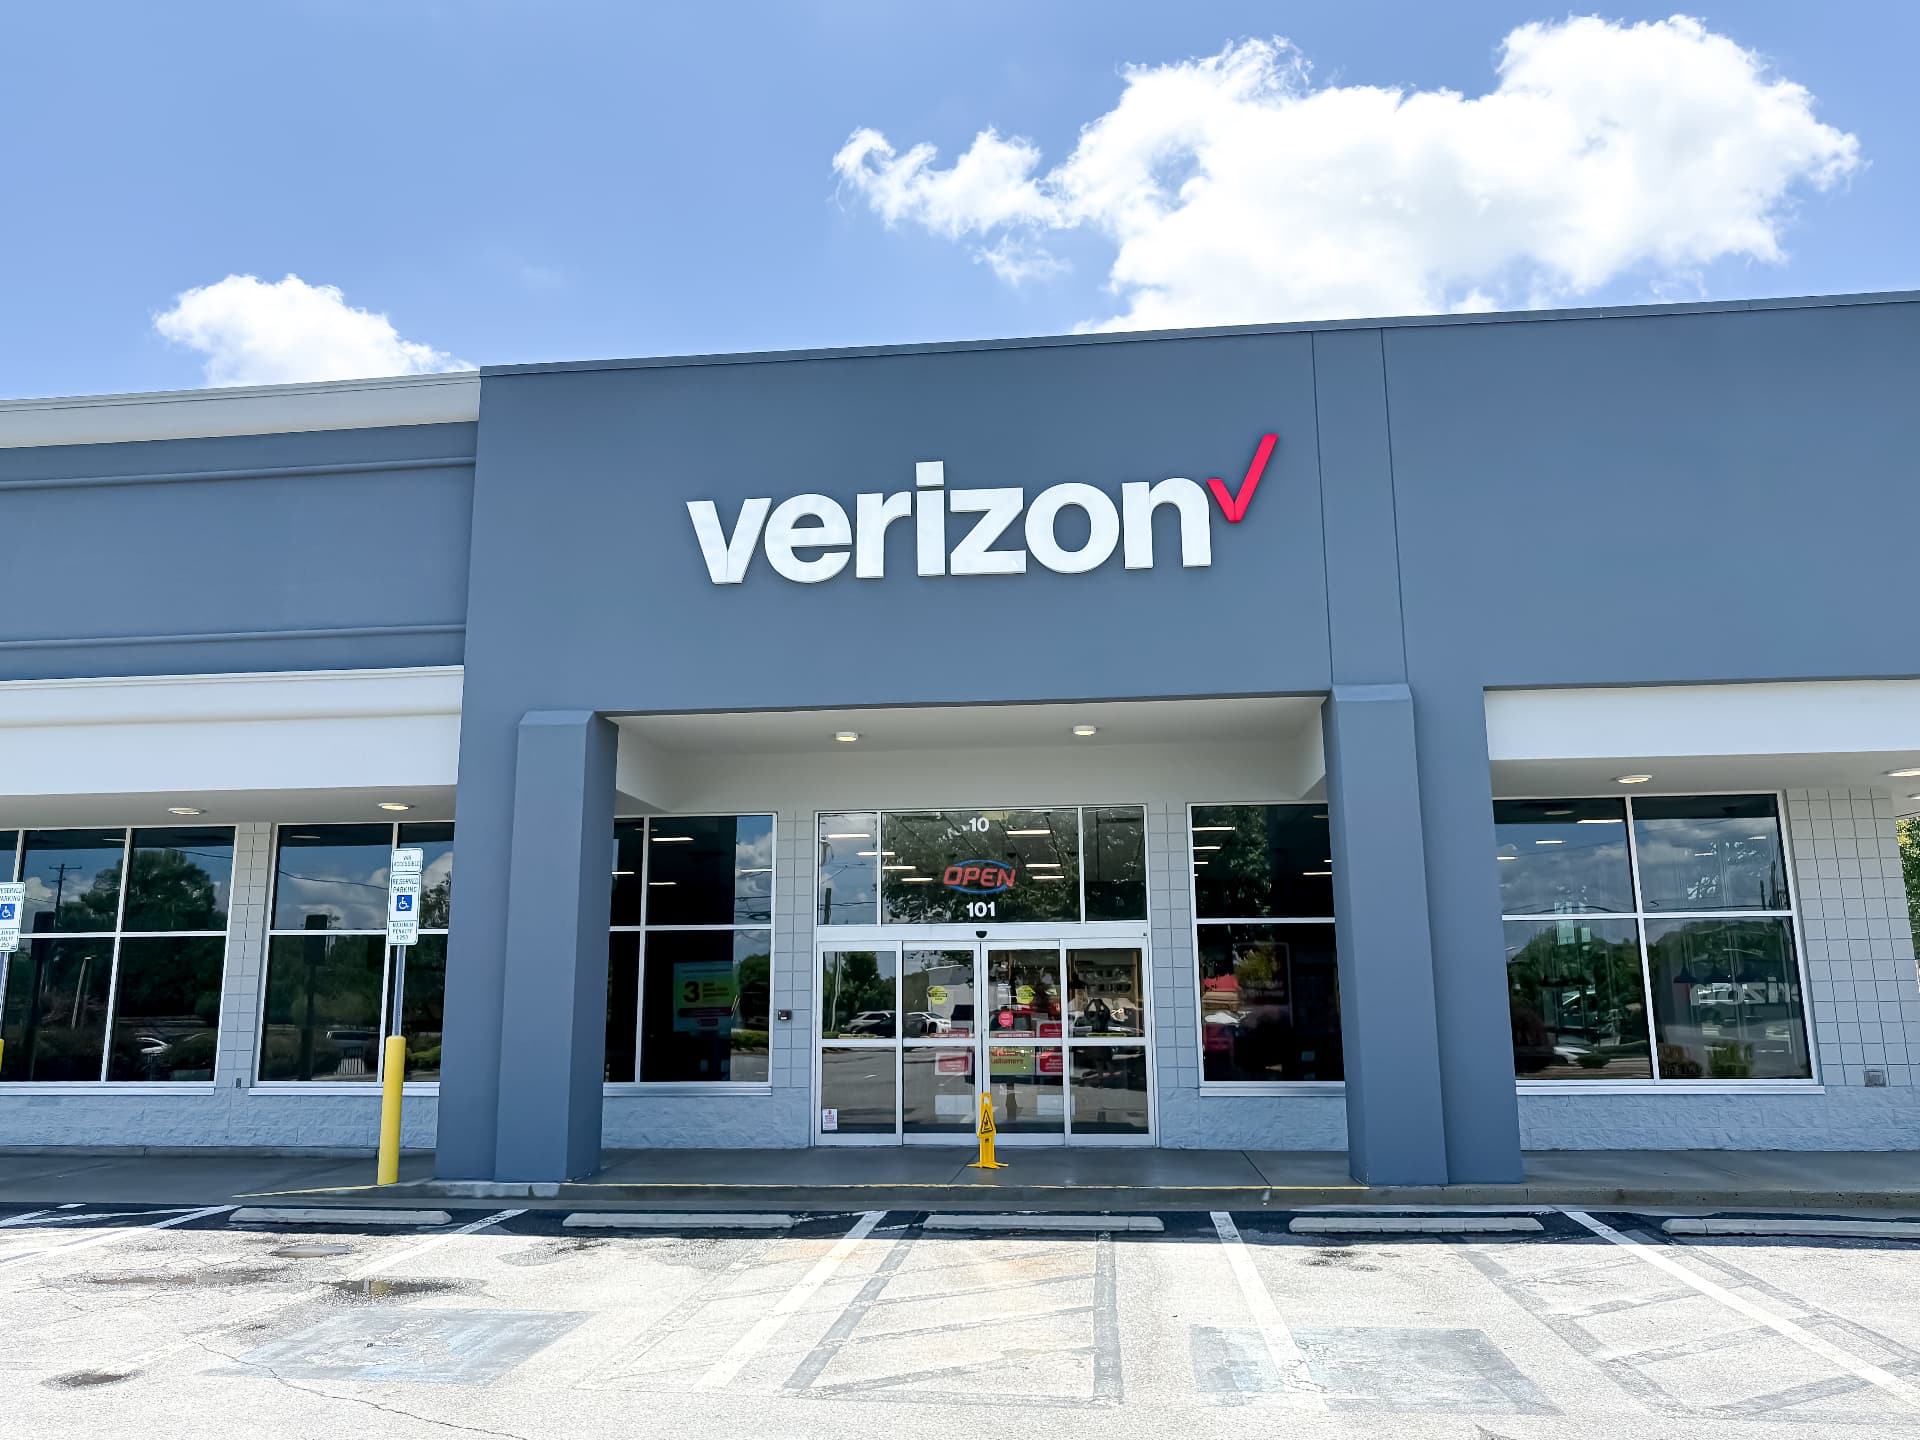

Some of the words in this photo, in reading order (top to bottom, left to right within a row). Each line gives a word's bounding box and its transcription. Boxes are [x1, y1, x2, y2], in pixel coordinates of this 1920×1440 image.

[686, 461, 1212, 585] verizon
[969, 817, 990, 832] 10
[943, 866, 1017, 888] OPEN
[966, 901, 996, 917] 101
[683, 980, 700, 1003] 3
